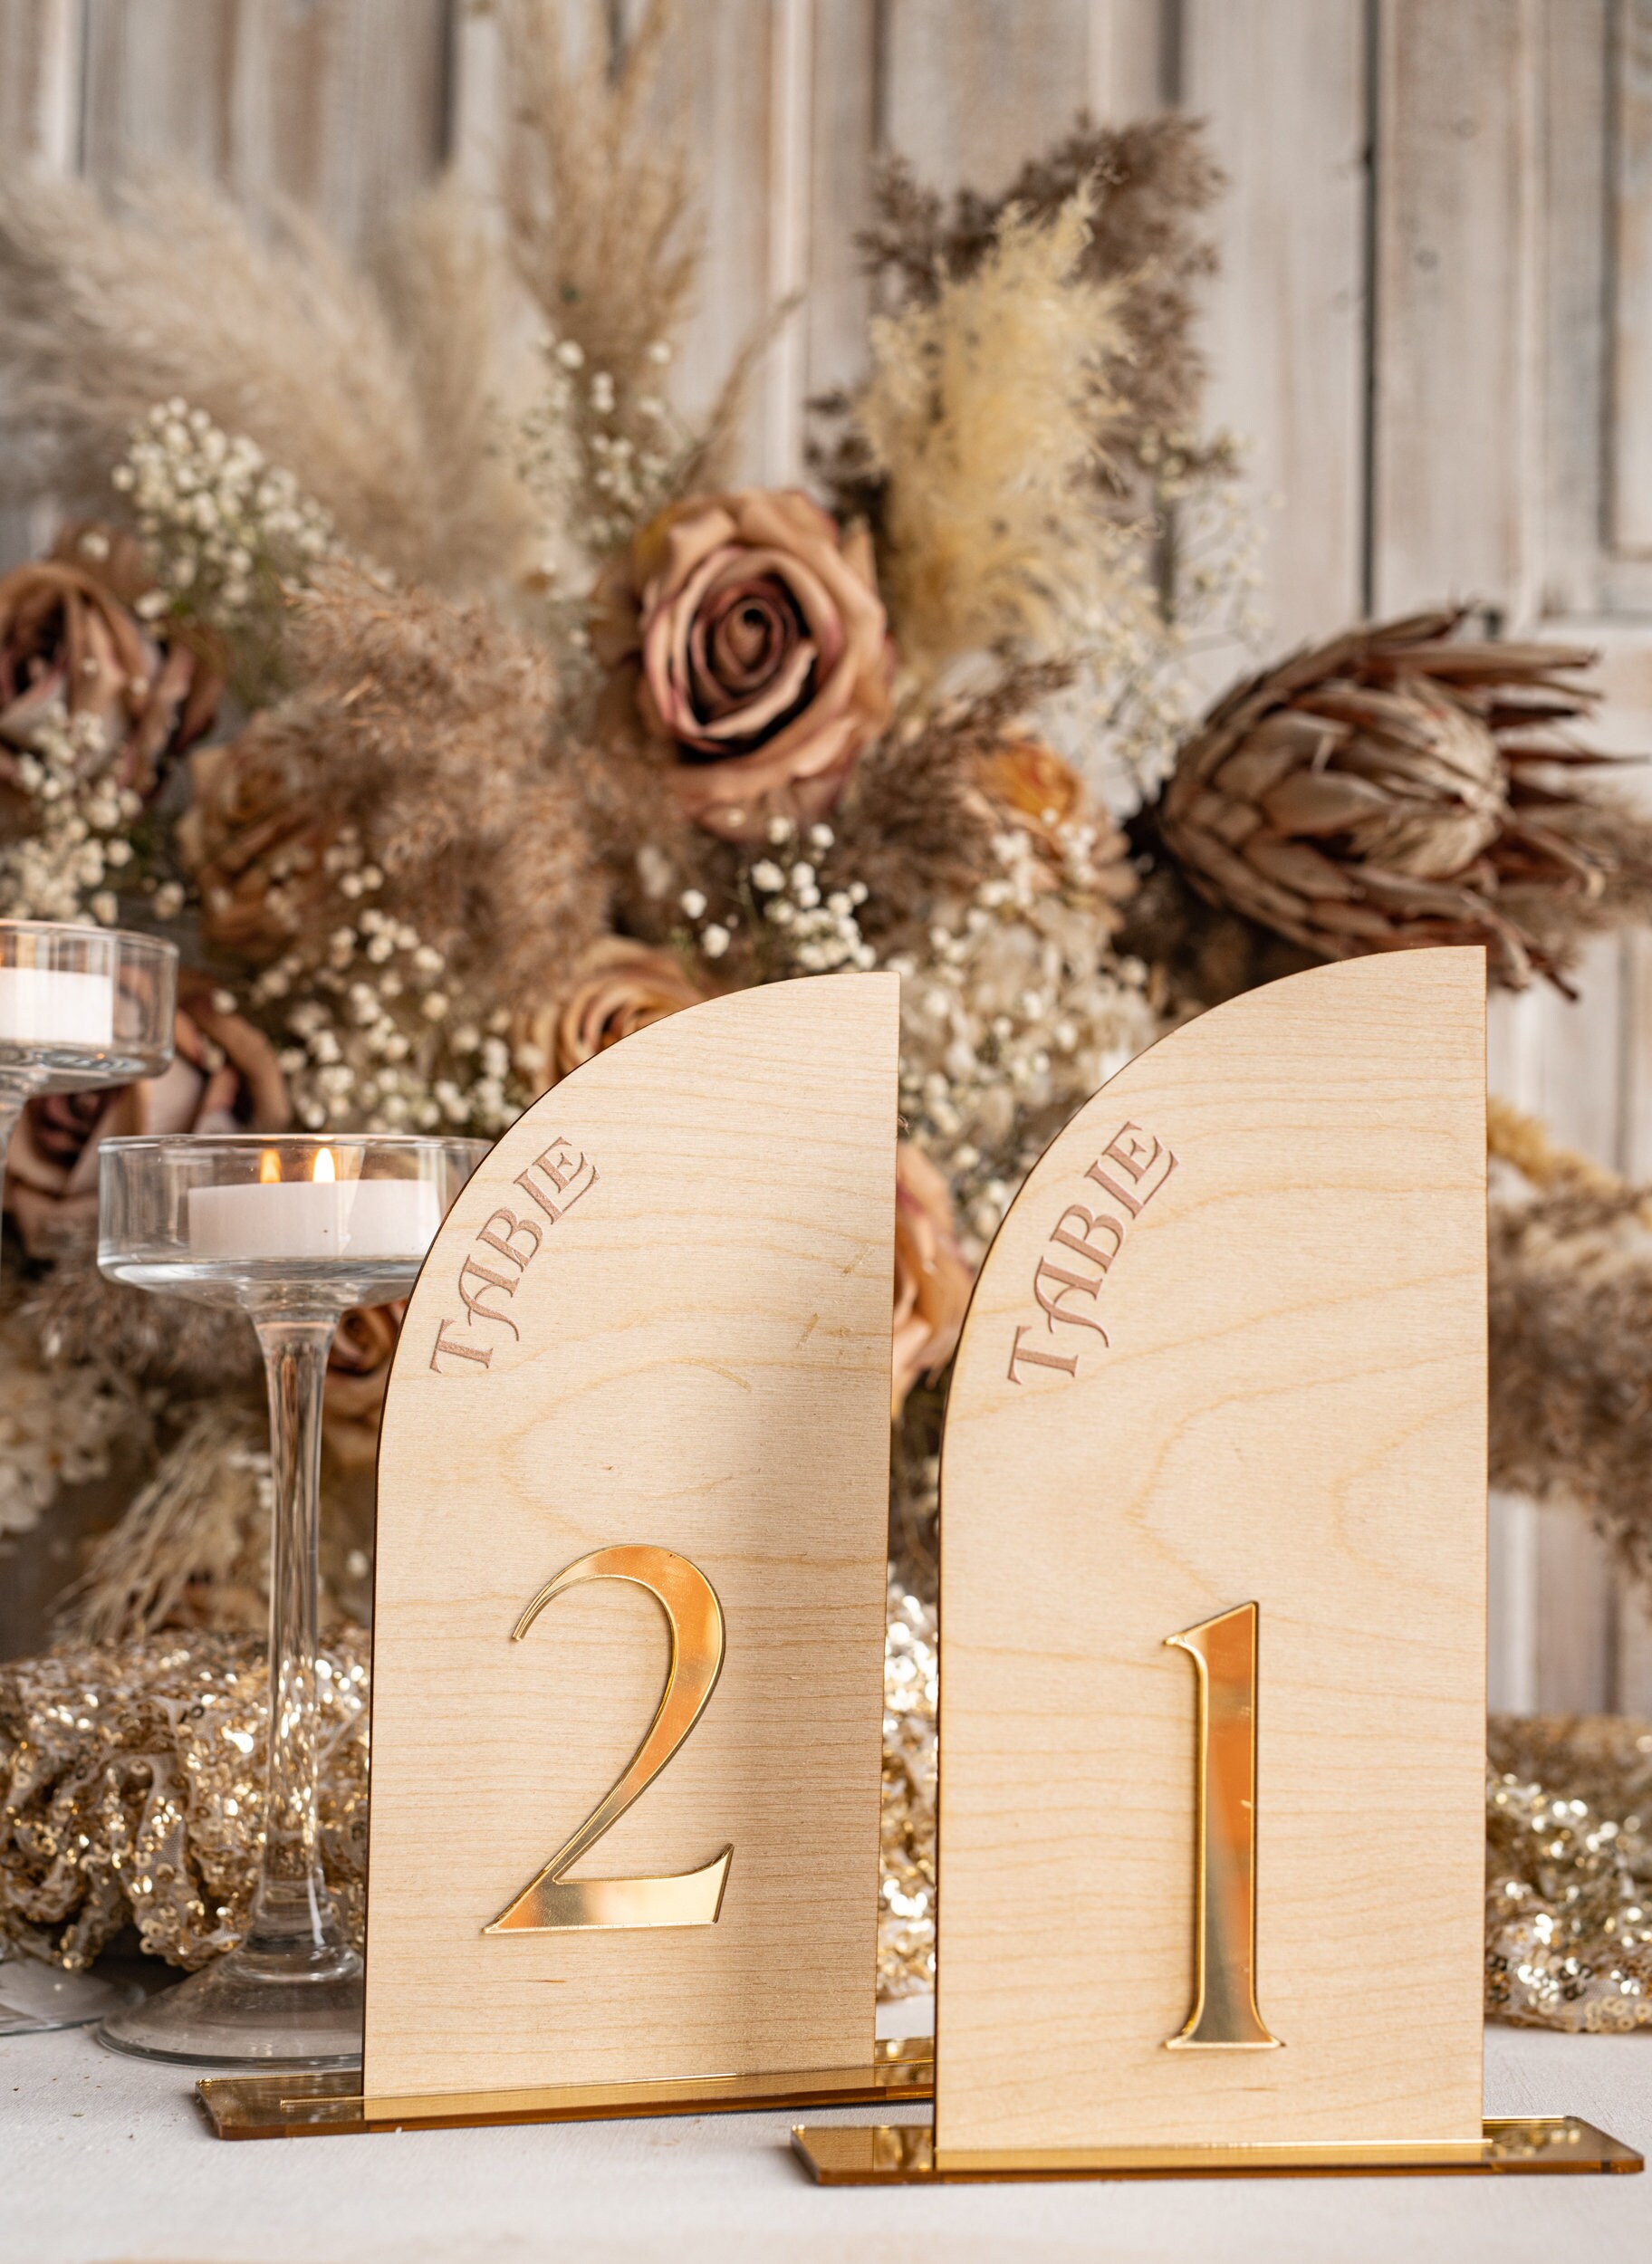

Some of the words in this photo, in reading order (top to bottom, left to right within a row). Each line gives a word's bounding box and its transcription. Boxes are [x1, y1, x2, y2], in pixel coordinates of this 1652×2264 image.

[428, 1136, 601, 1374] TABLE
[1006, 1120, 1179, 1385] TABLE
[481, 1543, 735, 1933] 2
[1163, 1600, 1285, 2049] 1
